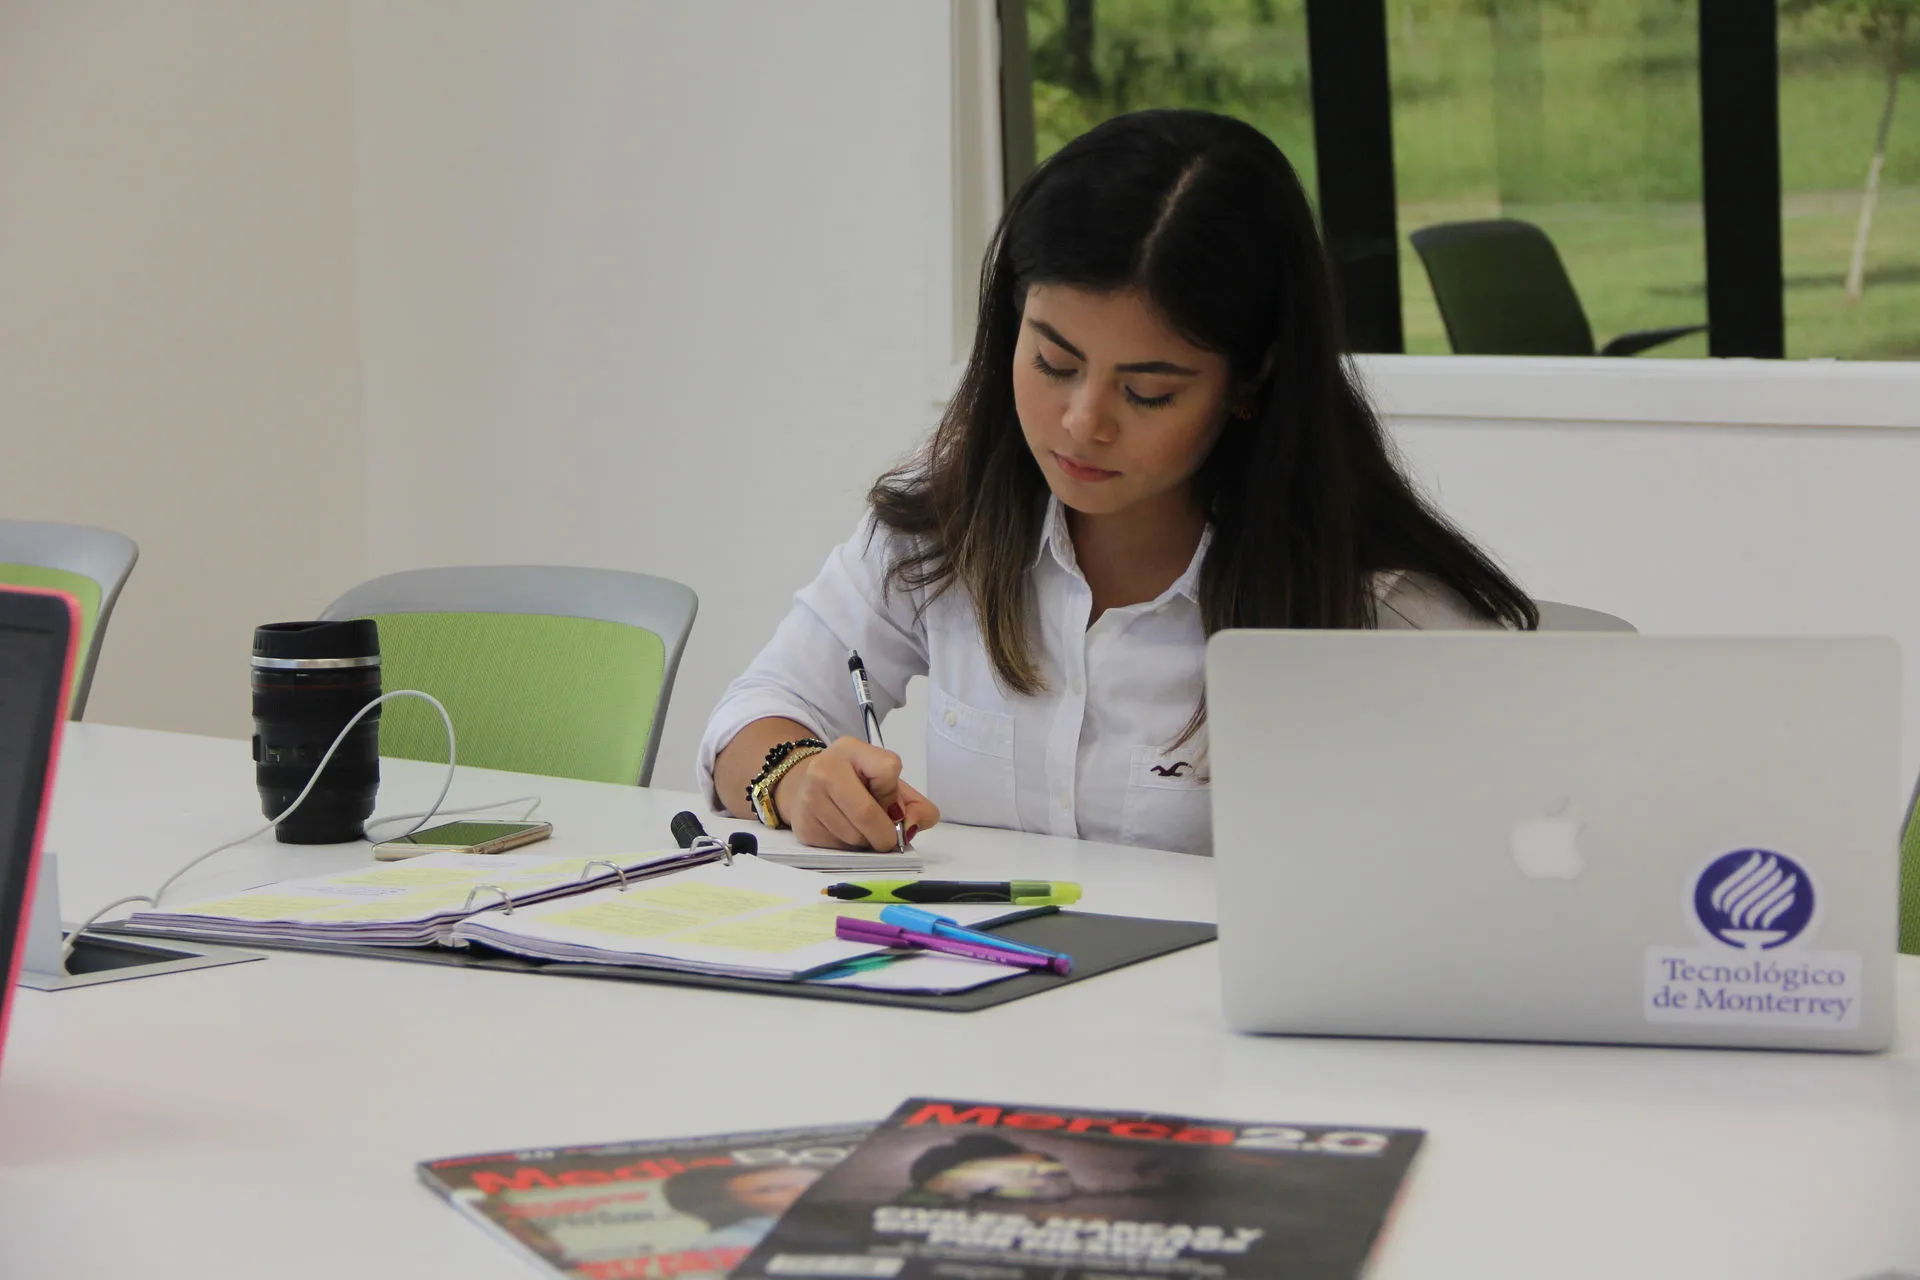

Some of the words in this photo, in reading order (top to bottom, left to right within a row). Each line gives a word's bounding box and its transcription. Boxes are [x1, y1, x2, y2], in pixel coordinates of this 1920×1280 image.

[1661, 957, 1846, 992] Tecnológico
[1652, 985, 1688, 1009] de
[1694, 987, 1853, 1021] Monterrey
